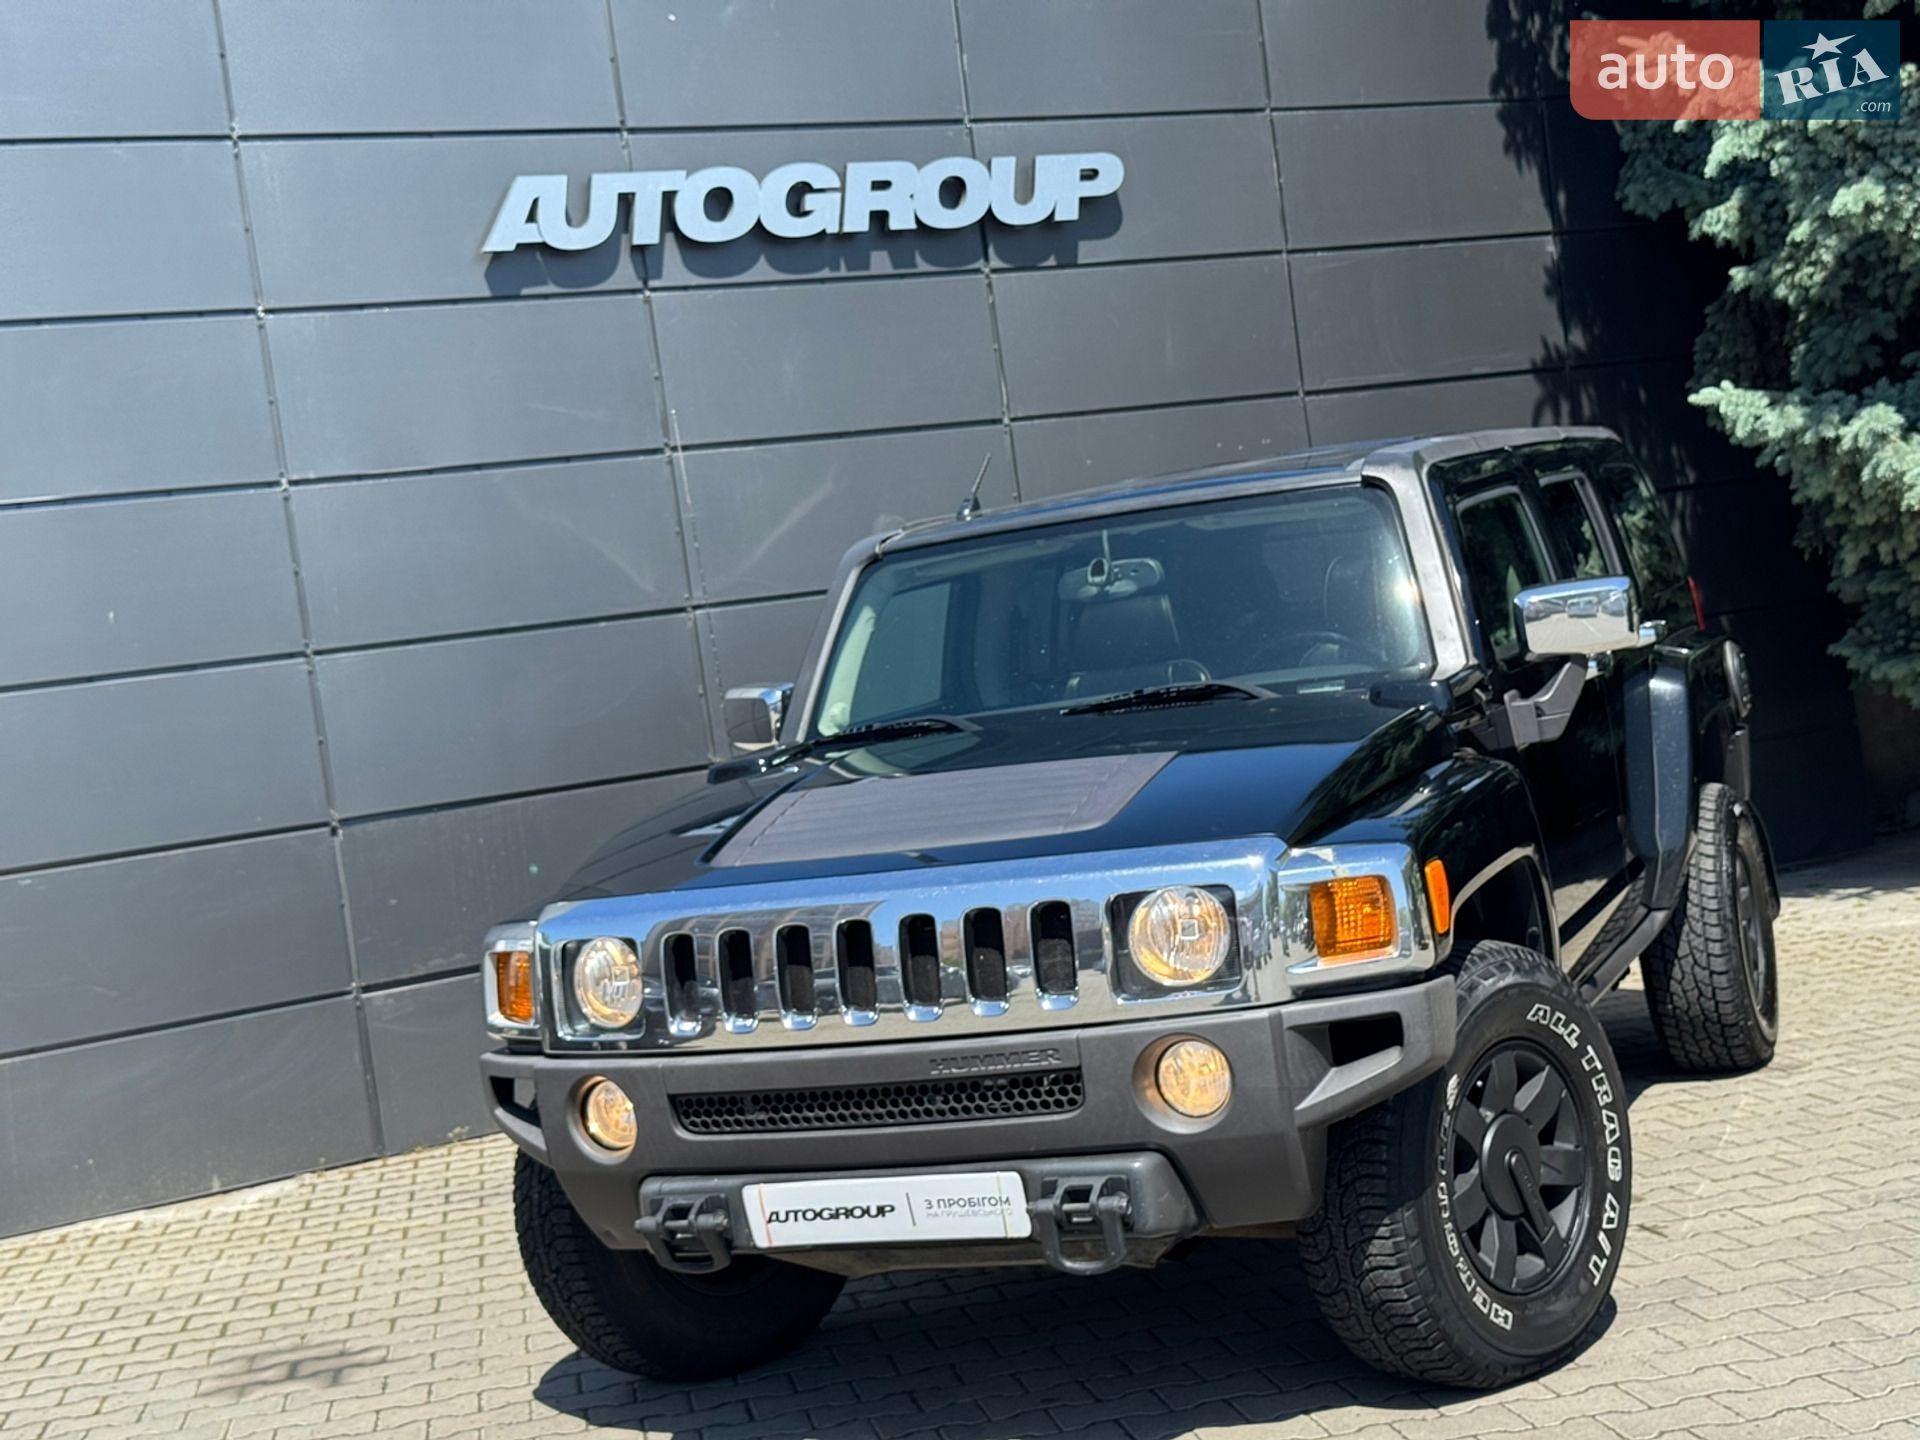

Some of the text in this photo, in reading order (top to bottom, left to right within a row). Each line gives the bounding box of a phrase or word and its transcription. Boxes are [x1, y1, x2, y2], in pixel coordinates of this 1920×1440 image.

[481, 151, 1125, 253] AUTOGROUP
[1526, 1003, 1581, 1050] ALL
[929, 1048, 1062, 1075] HUMMER
[766, 1204, 896, 1224] AUTOGROUP
[937, 1196, 1011, 1209] ПРОБІГОМ
